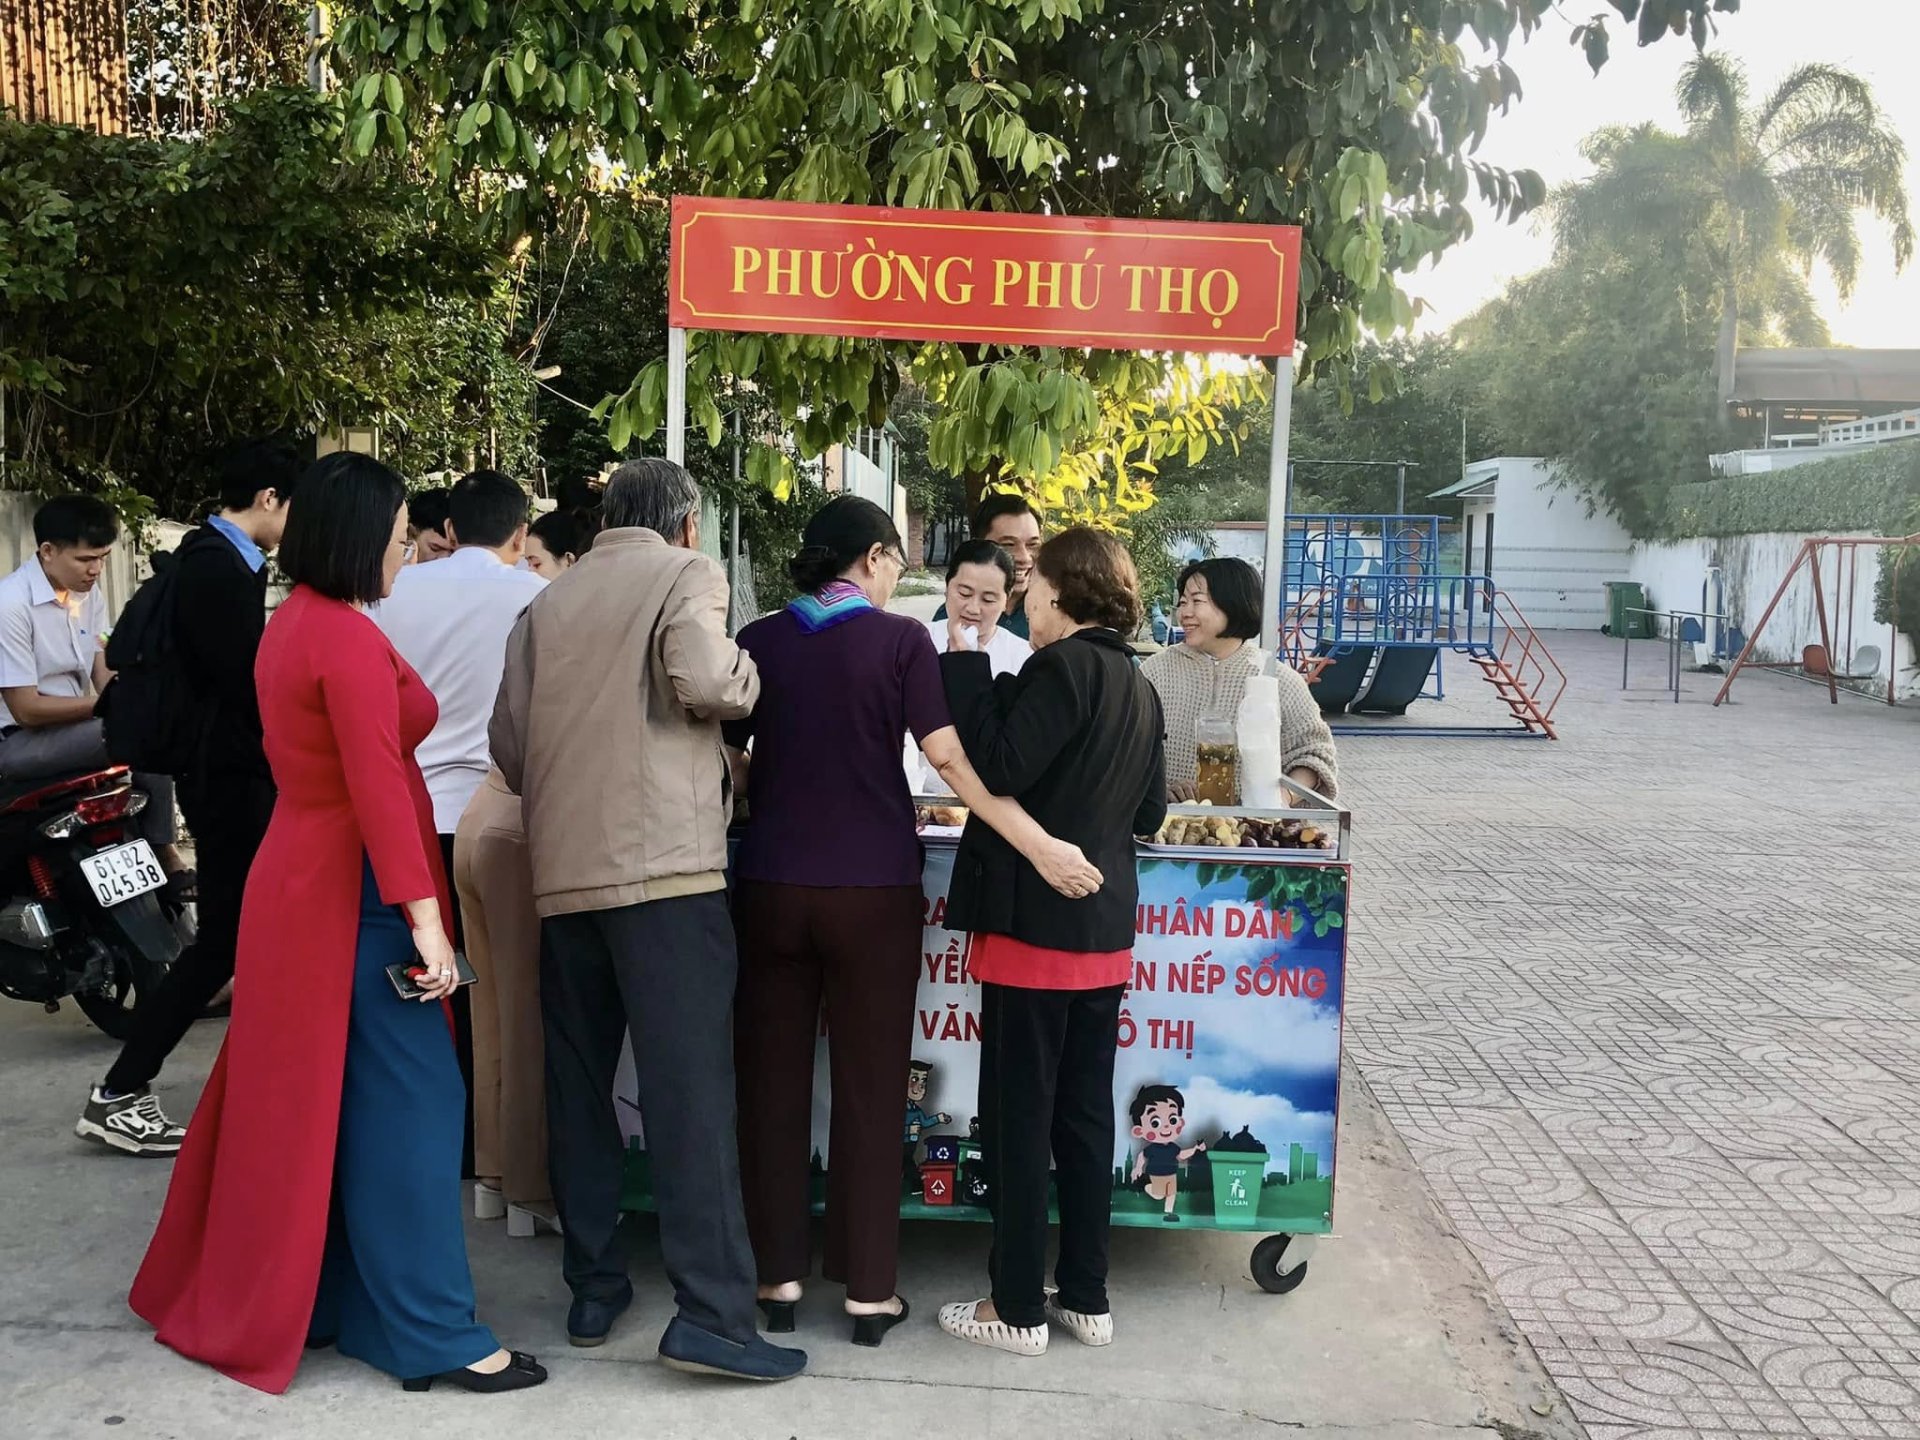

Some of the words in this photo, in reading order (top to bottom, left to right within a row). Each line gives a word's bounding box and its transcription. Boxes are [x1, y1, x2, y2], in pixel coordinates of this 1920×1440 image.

[729, 237, 975, 305] PHƯỜNG
[990, 248, 1105, 311] PHÚ
[1120, 264, 1239, 329] THỌ
[94, 846, 145, 879] 61-B2
[98, 864, 160, 902] 045.98
[1225, 900, 1293, 941] DÂN
[1167, 950, 1226, 994] NẾP
[1235, 953, 1328, 999] SỐNG
[919, 1003, 982, 1042] VĂN
[1147, 1018, 1194, 1060] THỊ
[1228, 1169, 1247, 1177] KEEP
[1224, 1199, 1249, 1207] CLEAN
